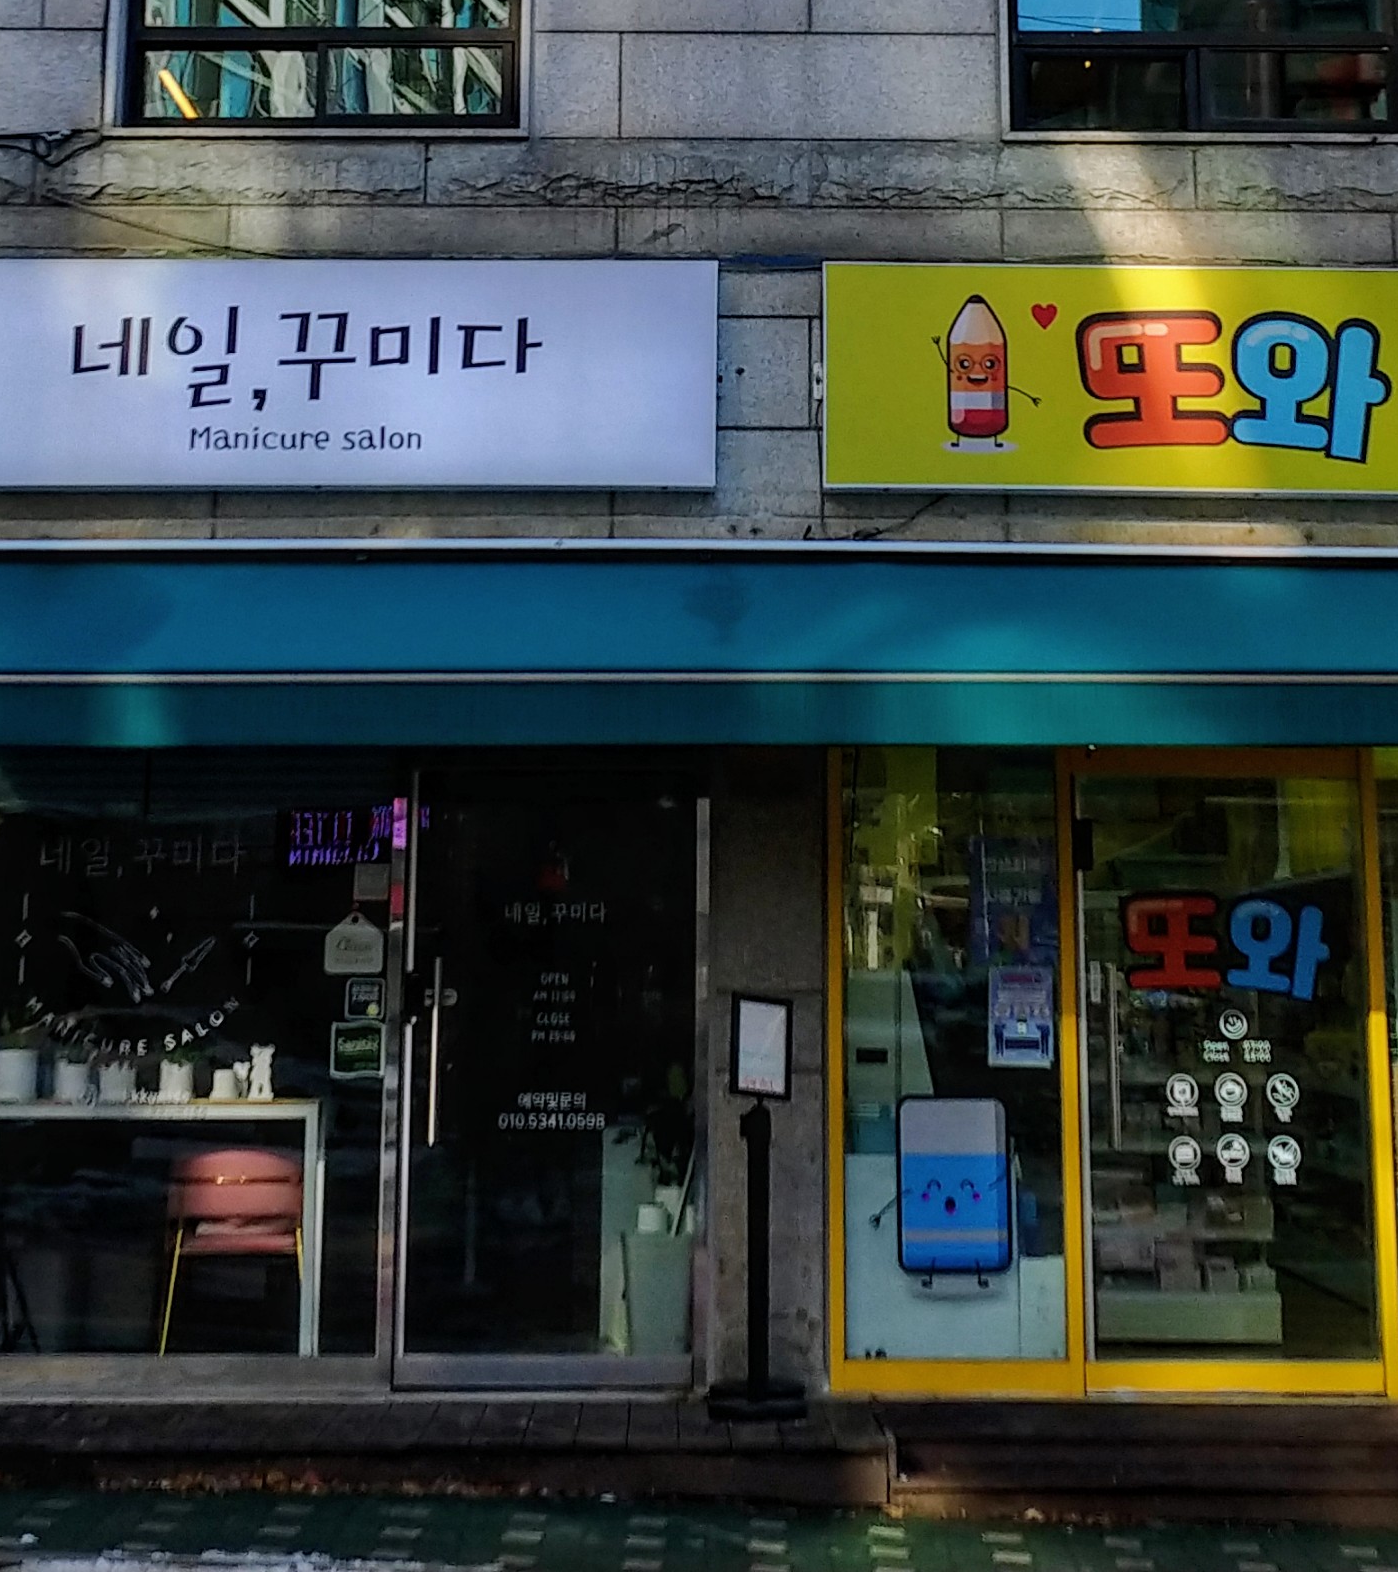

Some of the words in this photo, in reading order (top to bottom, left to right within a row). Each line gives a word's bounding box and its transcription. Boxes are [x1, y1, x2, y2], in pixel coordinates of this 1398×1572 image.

[70, 305, 543, 412] 네일,꾸미다
[1075, 309, 1392, 465] 또와
[188, 423, 330, 455] Manicure
[340, 424, 424, 455] salon
[39, 833, 248, 879] 네일,꾸미다
[1121, 891, 1333, 1002] 또와
[162, 995, 241, 1054] SALON
